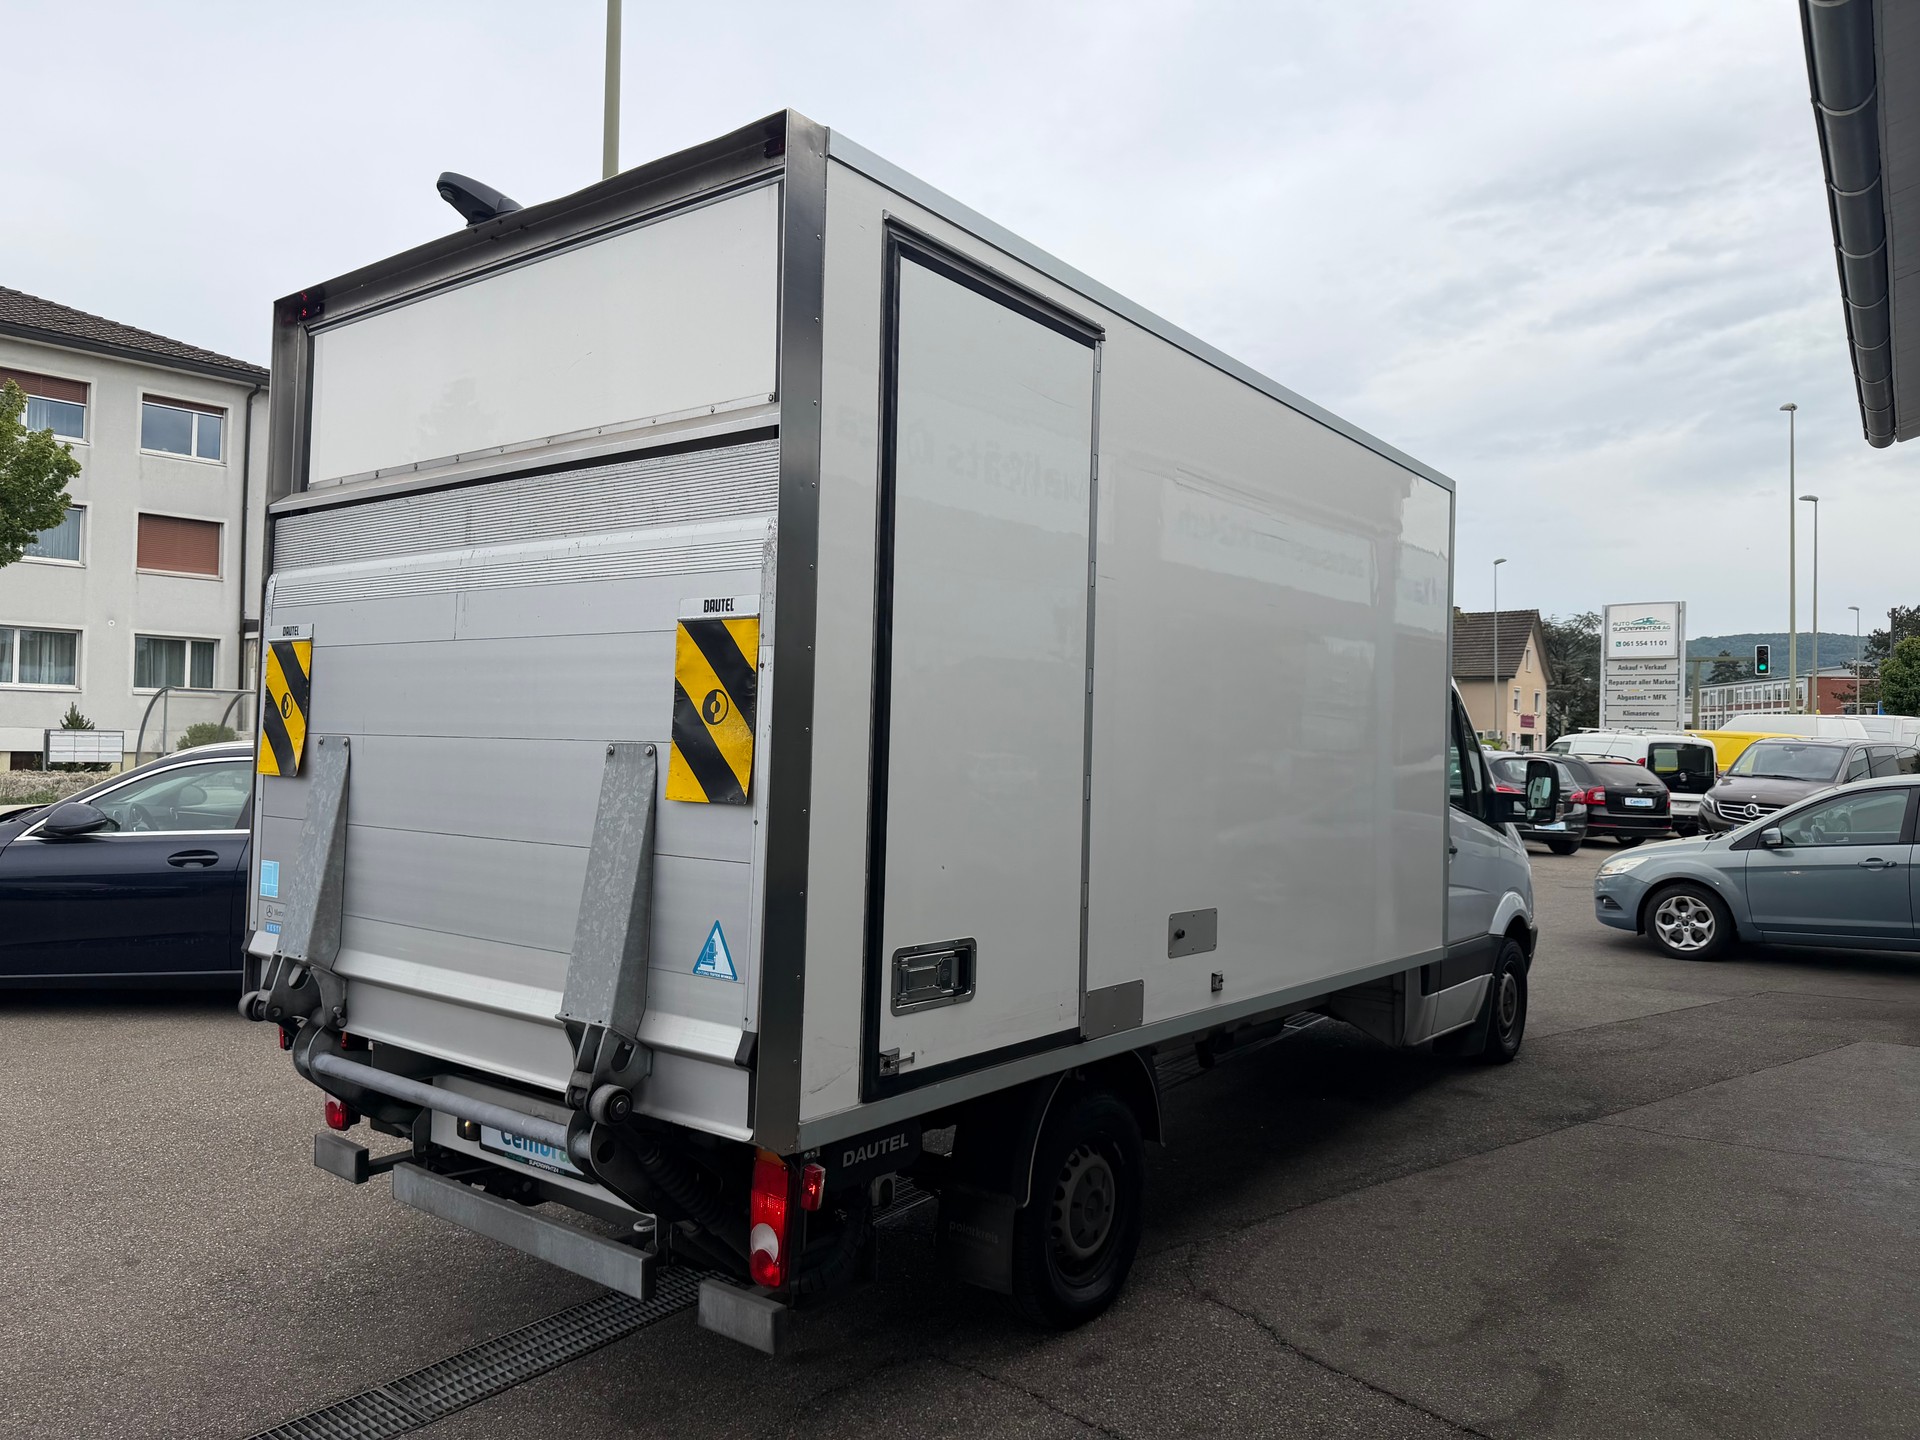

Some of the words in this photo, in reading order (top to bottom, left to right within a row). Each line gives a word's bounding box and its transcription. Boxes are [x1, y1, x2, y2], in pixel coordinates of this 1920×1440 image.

[704, 597, 735, 613] DAUTEL
[282, 625, 299, 636] DAUTEL
[842, 1133, 909, 1168] DAUTEL
